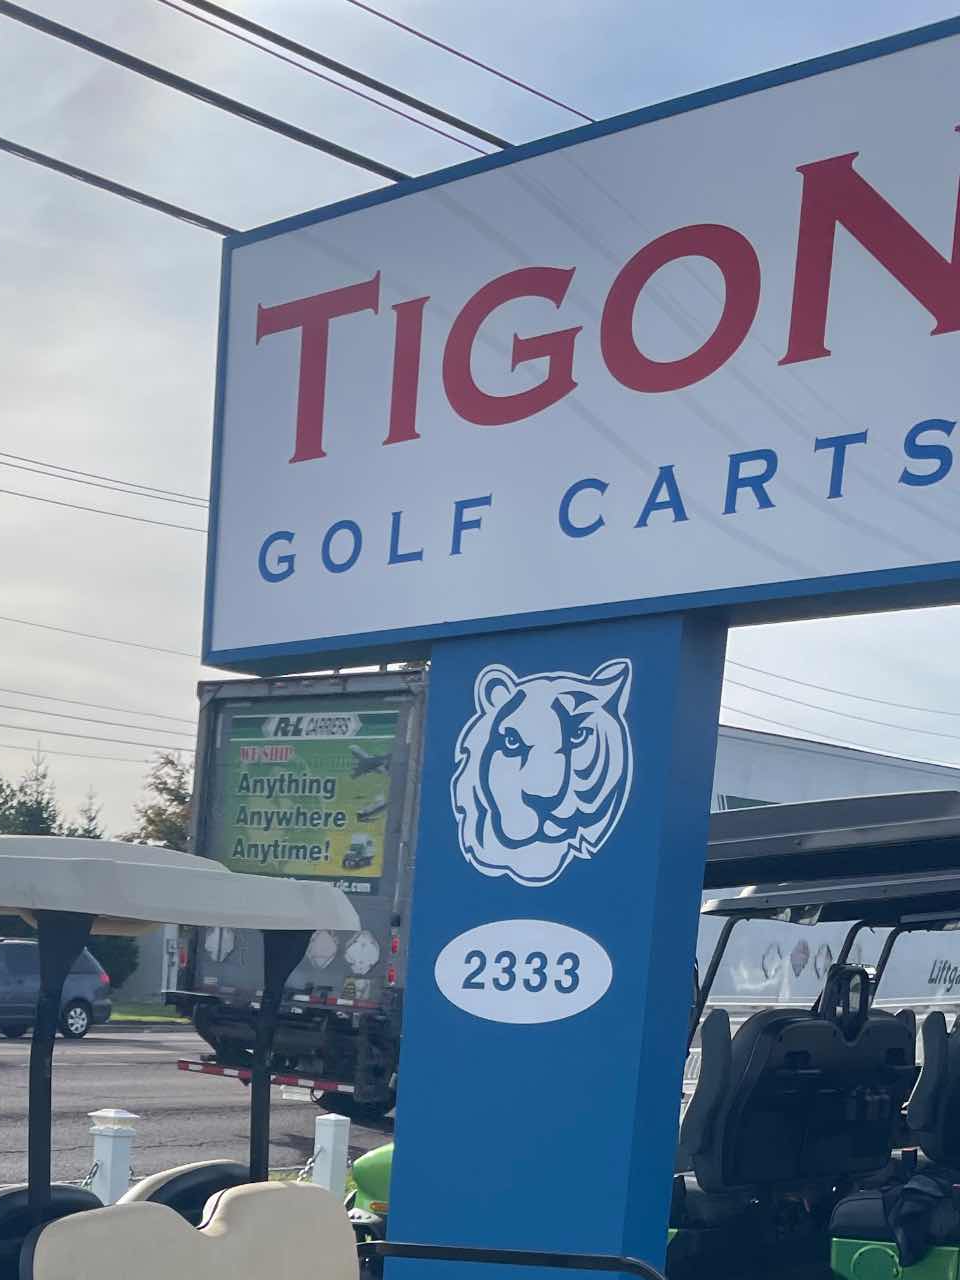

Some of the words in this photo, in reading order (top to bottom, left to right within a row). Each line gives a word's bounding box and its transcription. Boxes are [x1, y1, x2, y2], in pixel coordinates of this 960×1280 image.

[255, 123, 960, 465] TIGON
[257, 493, 494, 584] GOLF
[557, 418, 958, 540] CARTS
[238, 773, 336, 799] Anything
[236, 806, 346, 829] Anywhere
[232, 839, 330, 864] Anytime!
[461, 949, 581, 994] 2333
